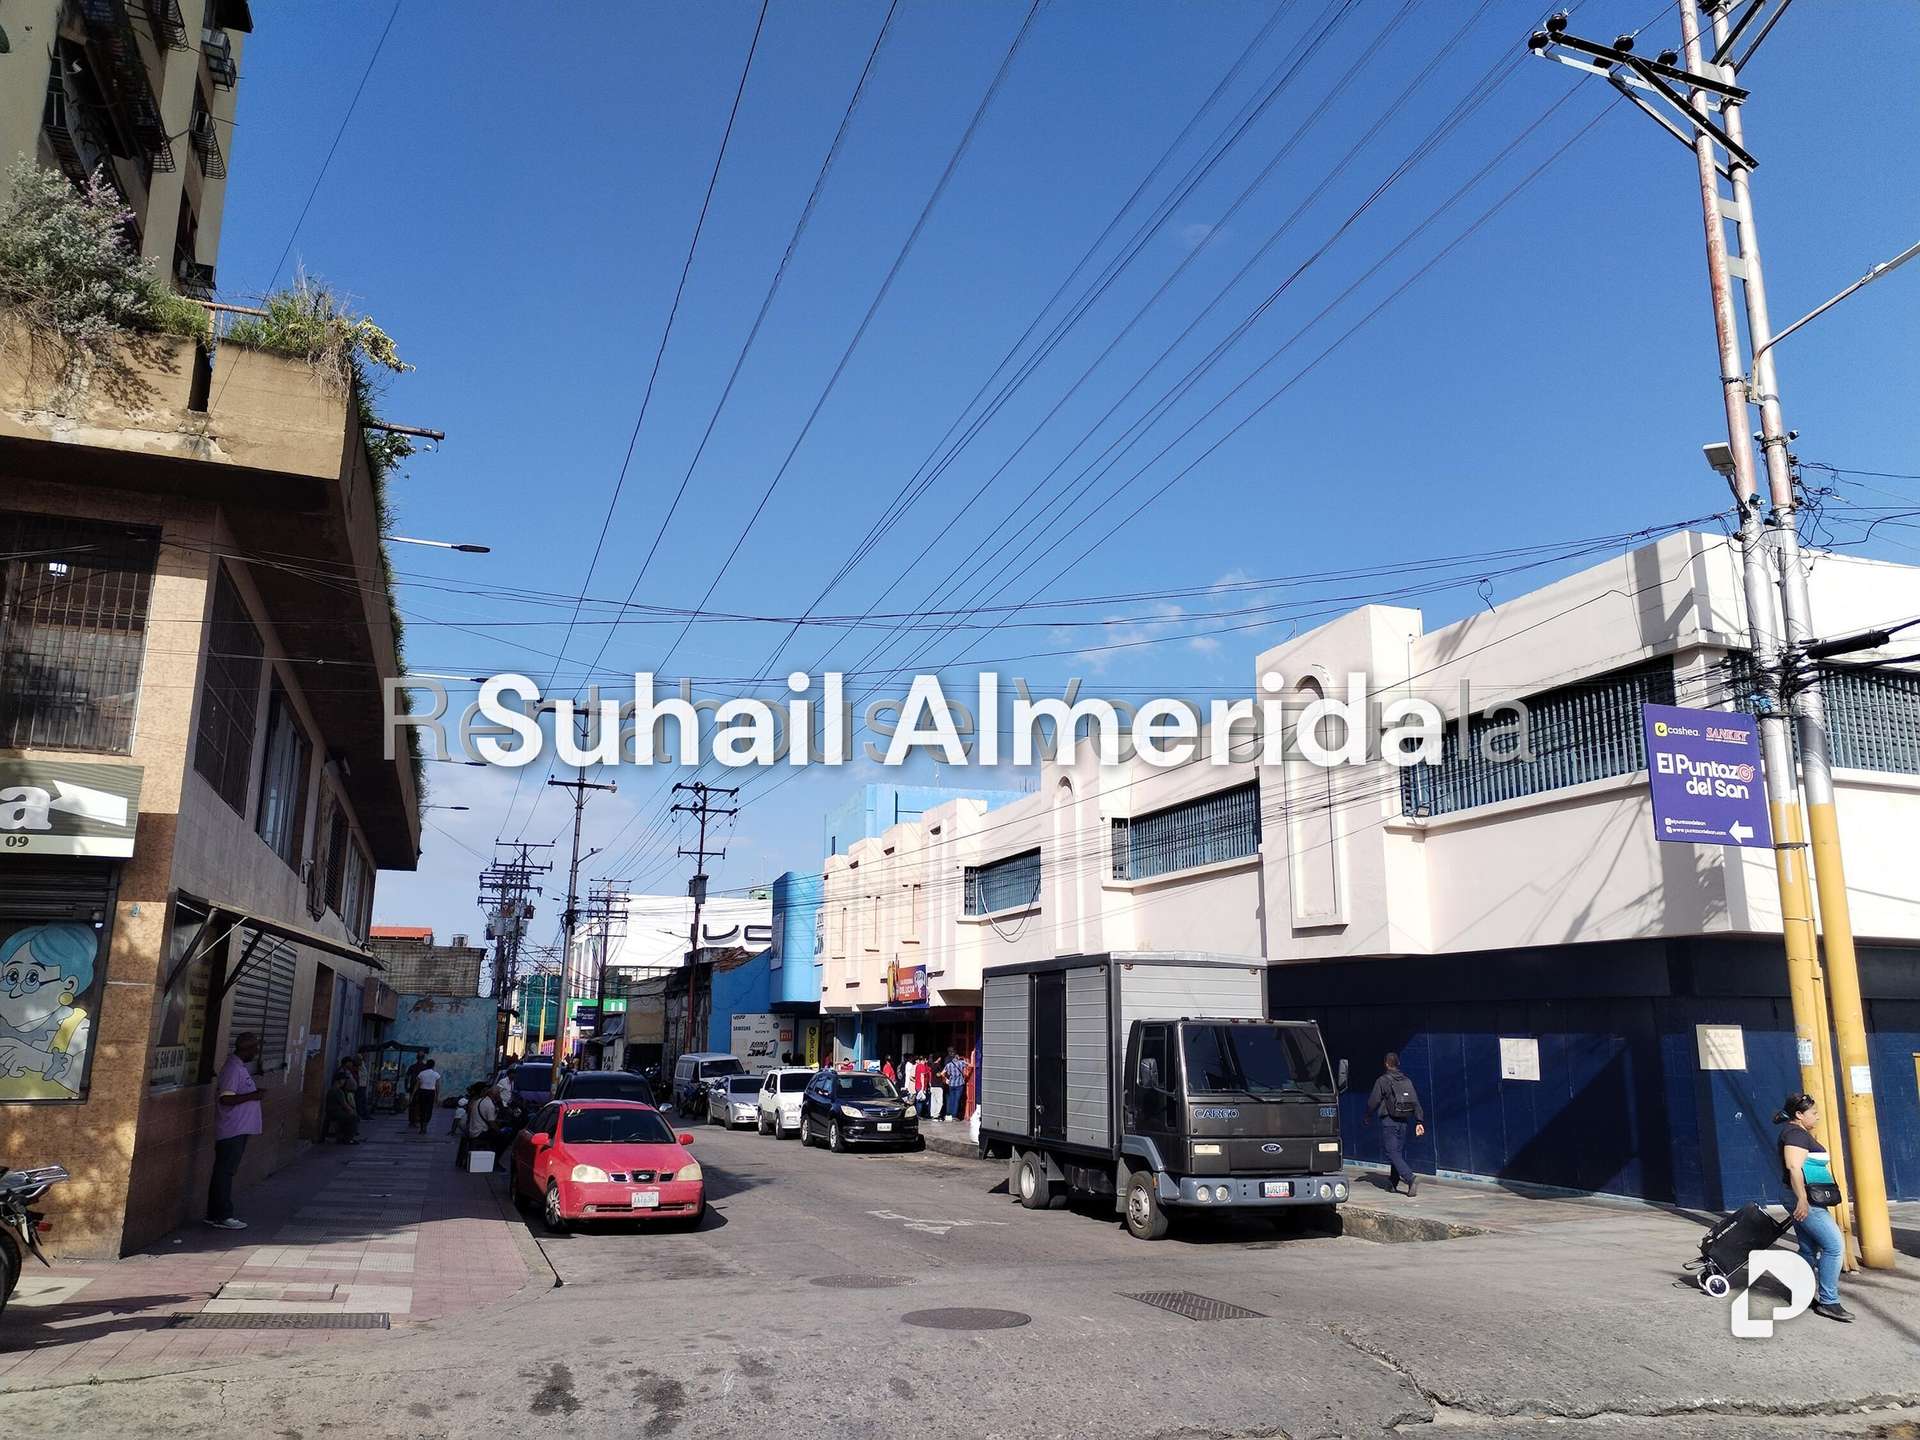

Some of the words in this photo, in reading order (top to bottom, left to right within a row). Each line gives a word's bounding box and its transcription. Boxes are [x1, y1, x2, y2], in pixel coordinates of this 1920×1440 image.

[1656, 752, 1675, 774] El
[1685, 776, 1713, 796] del
[5, 835, 29, 848] 09
[1193, 1108, 1240, 1119] CARGO
